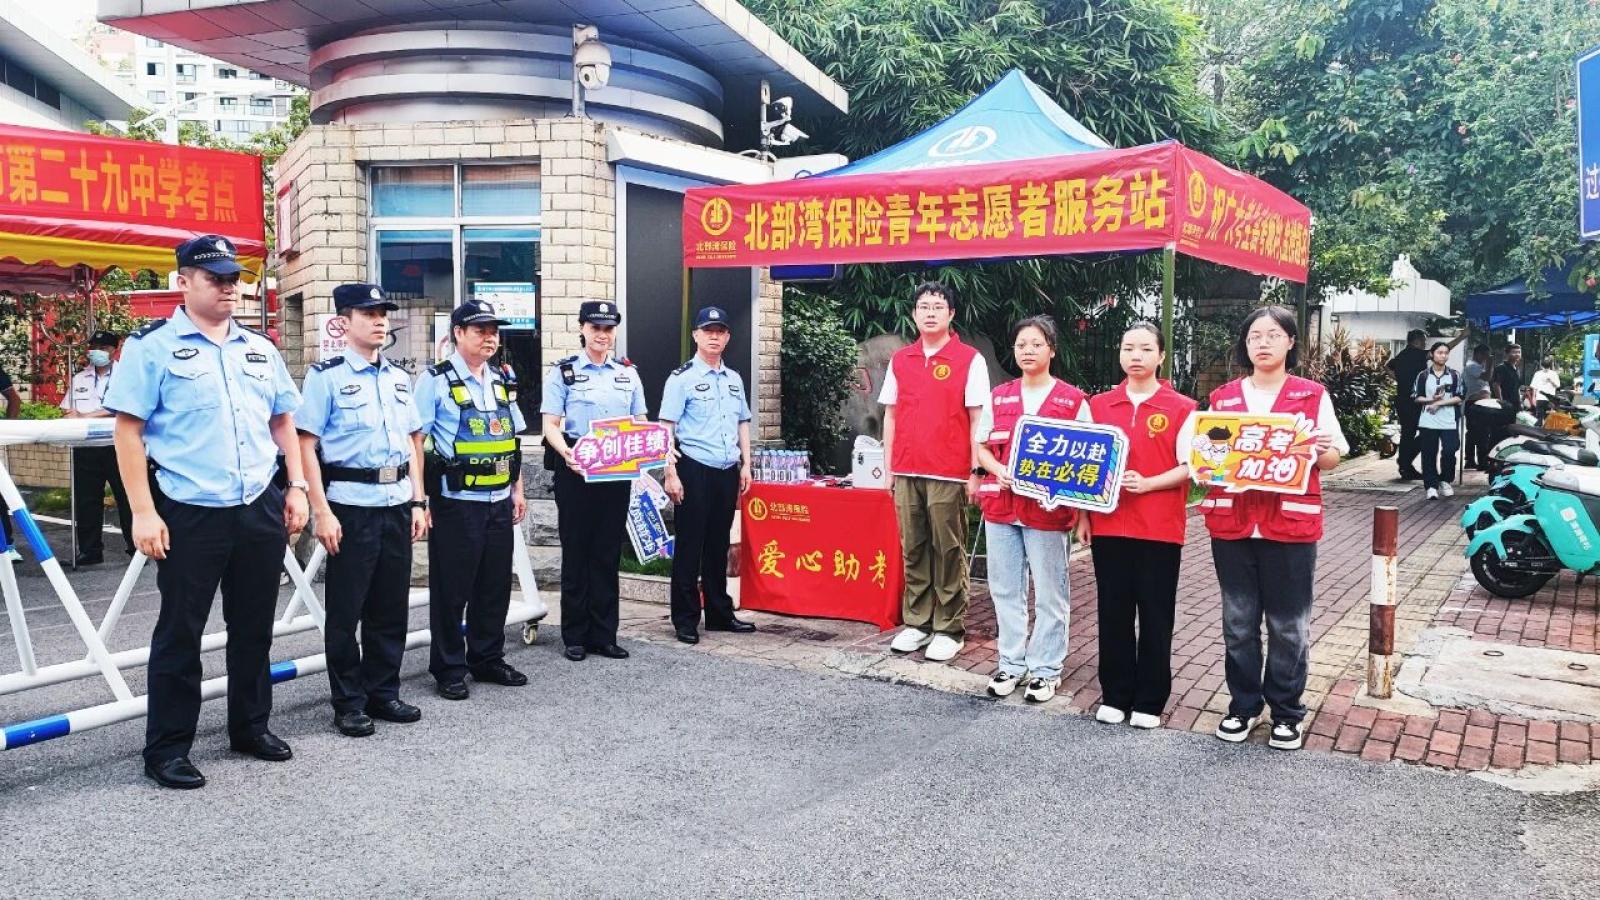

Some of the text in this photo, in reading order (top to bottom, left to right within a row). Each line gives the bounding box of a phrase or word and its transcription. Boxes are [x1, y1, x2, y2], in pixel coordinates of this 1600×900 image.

[0, 142, 239, 223] 第二十九中学考点
[744, 168, 1168, 251] 北部湾保险青年志愿者服务站
[577, 430, 667, 466] 争创佳绩
[1025, 431, 1107, 462] 全力以赴
[1235, 424, 1295, 453] 高考
[1018, 458, 1100, 488] 势在必得
[1236, 456, 1299, 483] 加油
[758, 540, 888, 589] 爱心助考
